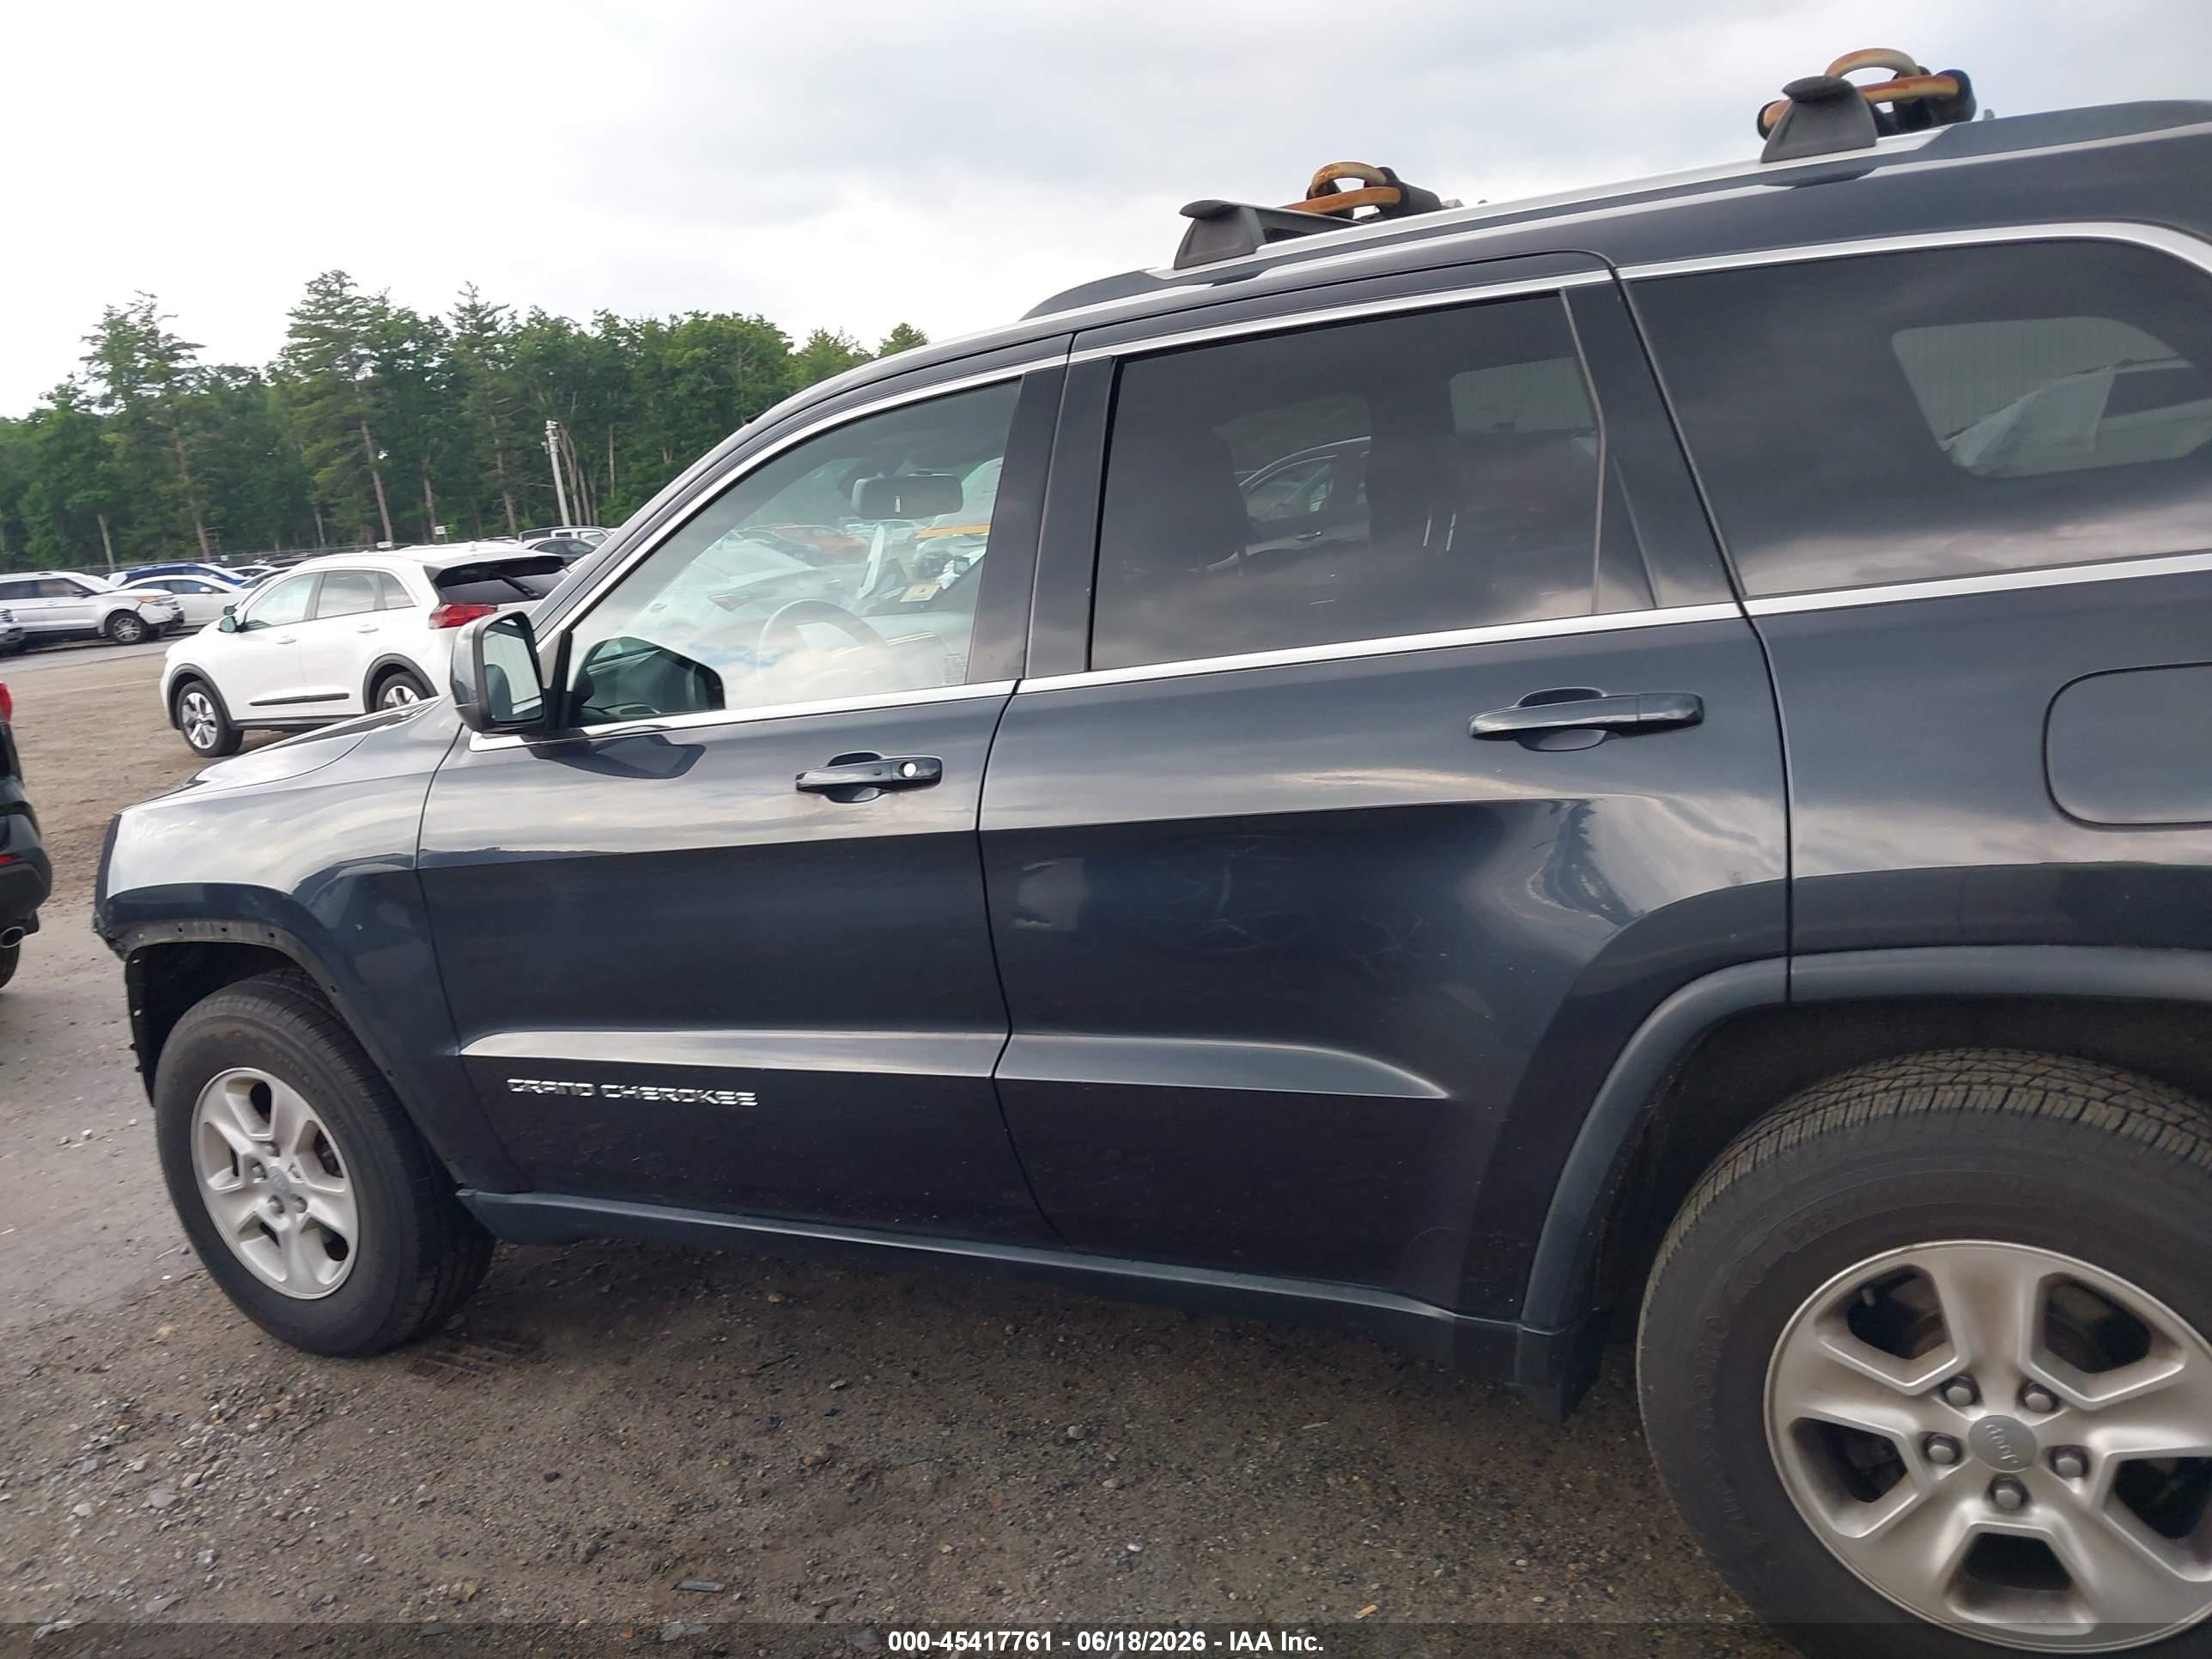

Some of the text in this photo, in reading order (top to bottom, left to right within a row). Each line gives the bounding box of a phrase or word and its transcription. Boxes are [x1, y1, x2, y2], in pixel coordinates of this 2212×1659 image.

[506, 1078, 759, 1108] GRAND CHEROKEE
[1984, 1423, 2020, 1464] Jeep
